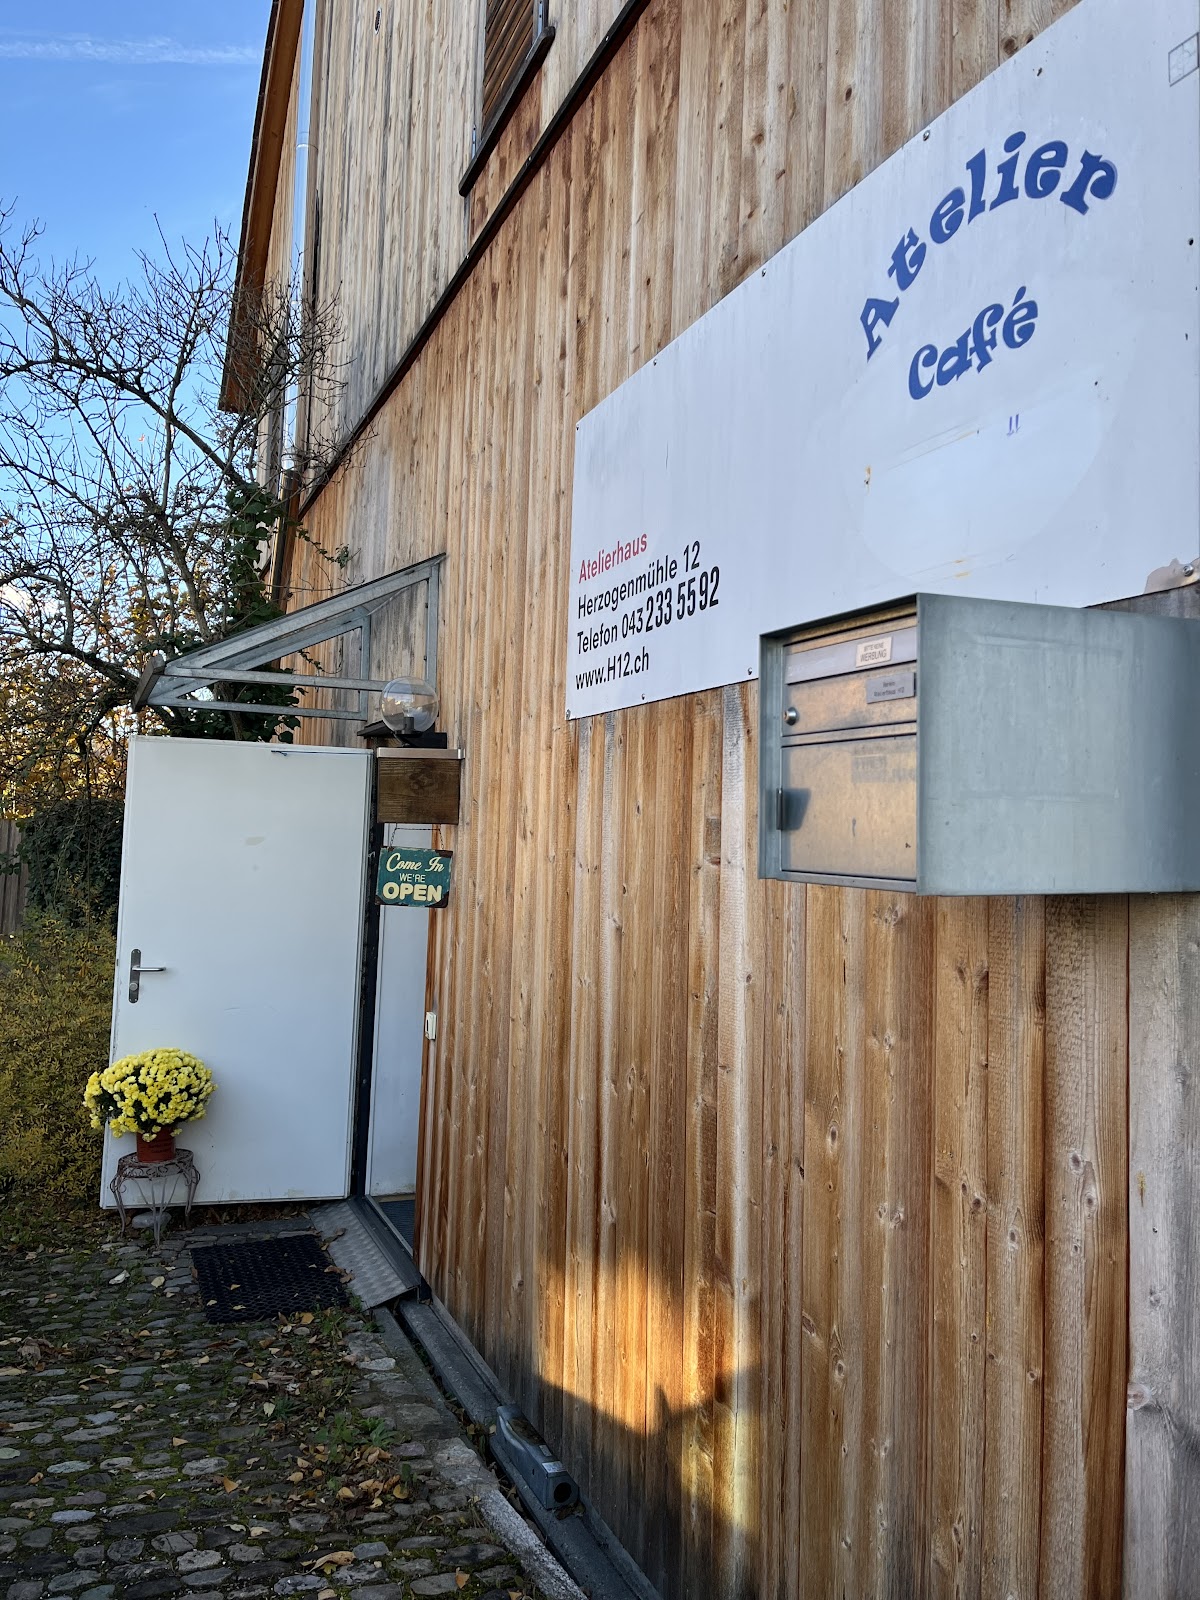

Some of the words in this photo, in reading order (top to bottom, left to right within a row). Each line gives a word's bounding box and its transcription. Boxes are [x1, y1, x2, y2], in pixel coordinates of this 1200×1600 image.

[860, 131, 1118, 363] Atelier
[908, 286, 1038, 400] Café
[578, 533, 648, 584] Atelierhaus
[578, 555, 678, 619] Herzogenmühle
[683, 540, 701, 573] 12
[577, 623, 618, 655] Telefon
[621, 607, 643, 639] 043
[645, 587, 673, 633] 233
[575, 646, 649, 690] www.H12.ch
[861, 649, 886, 662] WERBUNG
[386, 852, 422, 872] Come
[425, 856, 444, 872] In
[399, 873, 426, 883] WE'RE
[382, 882, 443, 902] OPEN
